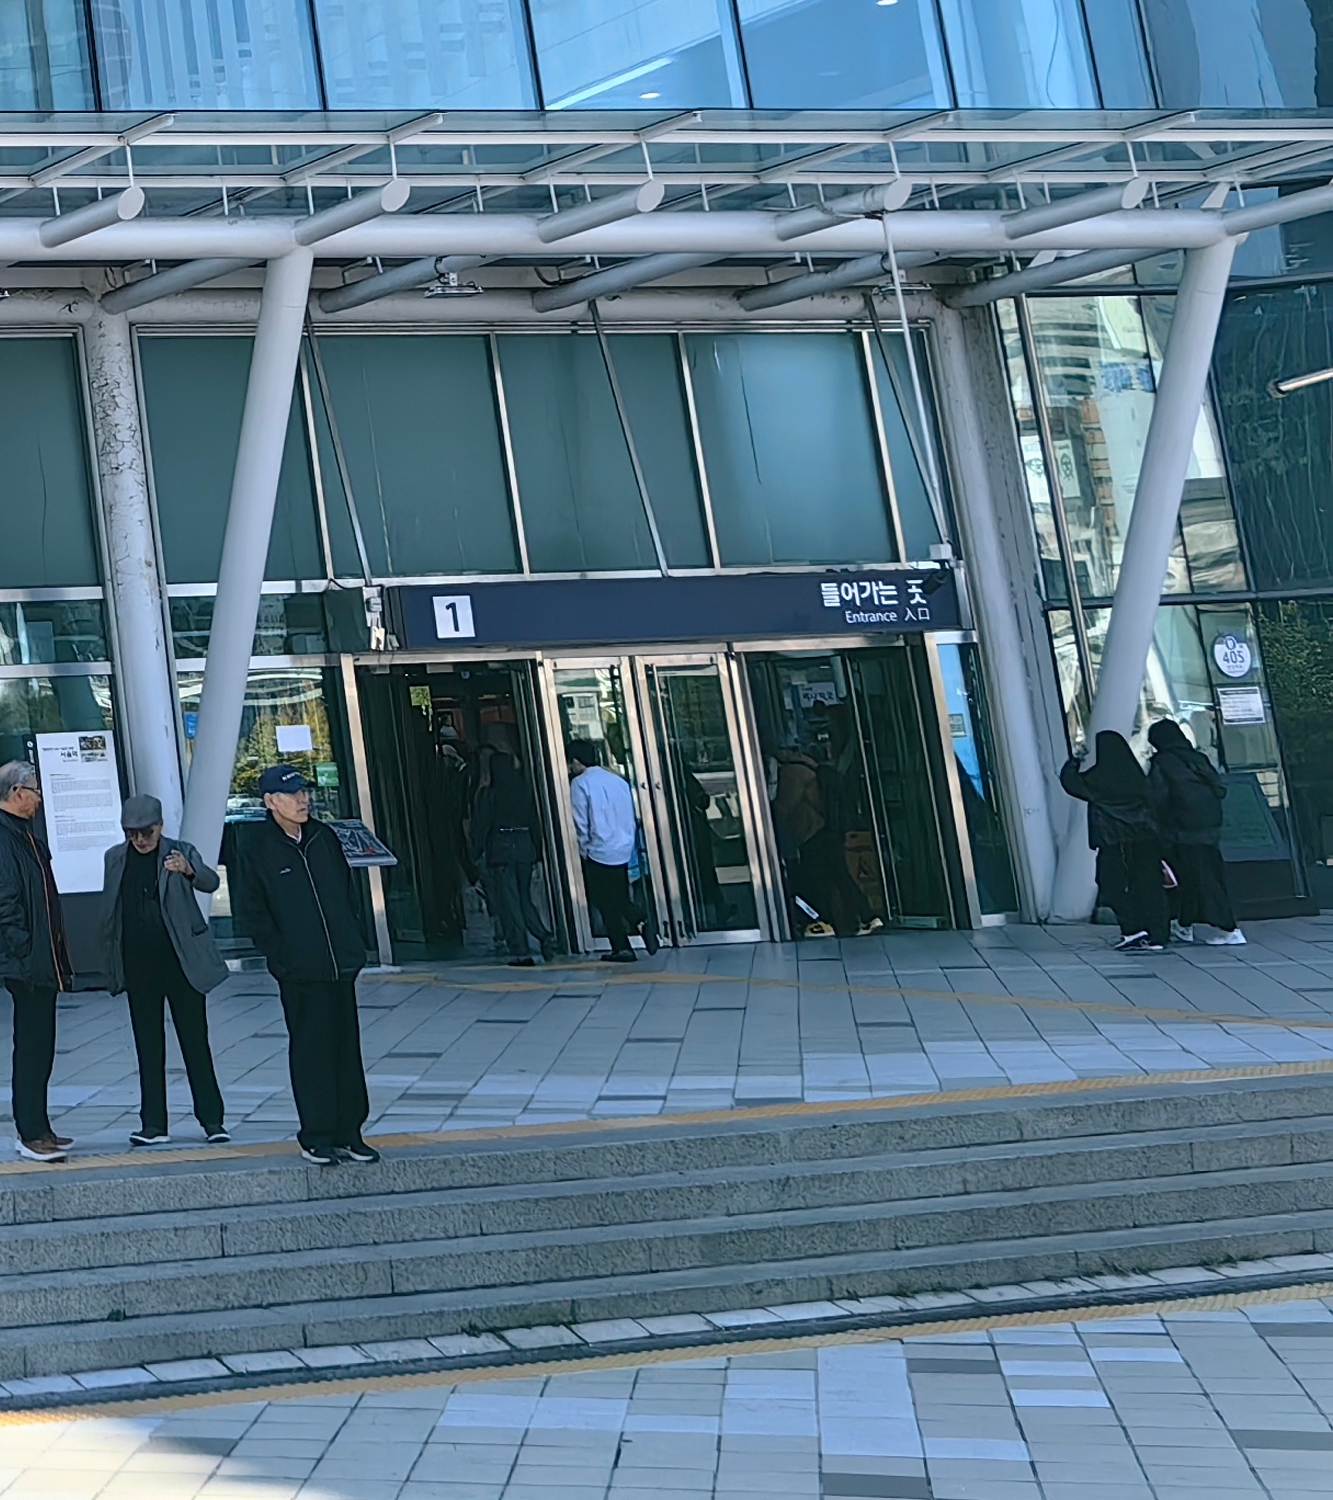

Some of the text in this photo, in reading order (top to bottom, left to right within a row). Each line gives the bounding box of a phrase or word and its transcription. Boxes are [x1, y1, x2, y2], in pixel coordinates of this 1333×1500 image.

[820, 580, 899, 607] 들어가는
[445, 602, 460, 632] 1
[845, 607, 931, 623] Entrance 入口
